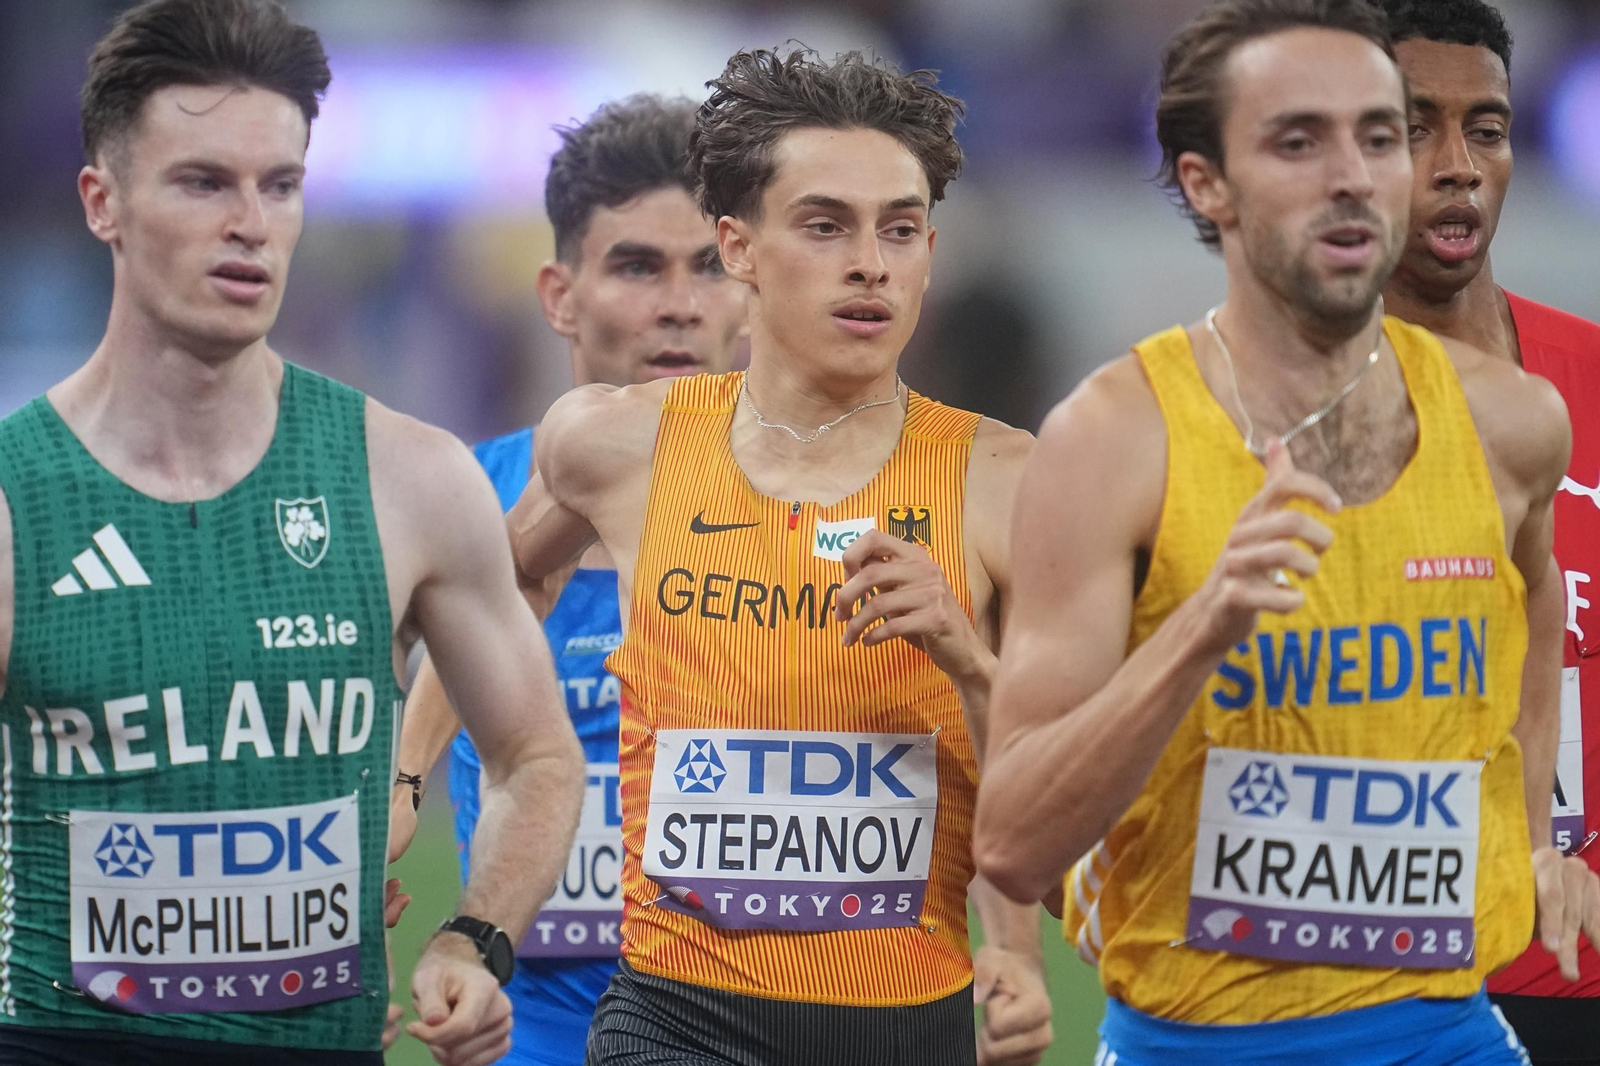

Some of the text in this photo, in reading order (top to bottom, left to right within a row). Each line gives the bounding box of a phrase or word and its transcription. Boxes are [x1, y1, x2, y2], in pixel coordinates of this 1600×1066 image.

[816, 528, 861, 551] WG
[1407, 558, 1493, 578] BAUHAUS
[256, 614, 358, 648] 123.ie
[1212, 616, 1487, 710] SWEDEN
[24, 677, 375, 775] IRELAND
[726, 739, 917, 798] TDK
[1292, 765, 1461, 828] TDK
[153, 810, 342, 877] TDK
[658, 812, 923, 874] STEPANOV
[1213, 833, 1463, 905] KRAMER
[1556, 830, 1572, 851] 5
[87, 882, 349, 956] McPHILLIPS
[536, 921, 618, 945] TOK
